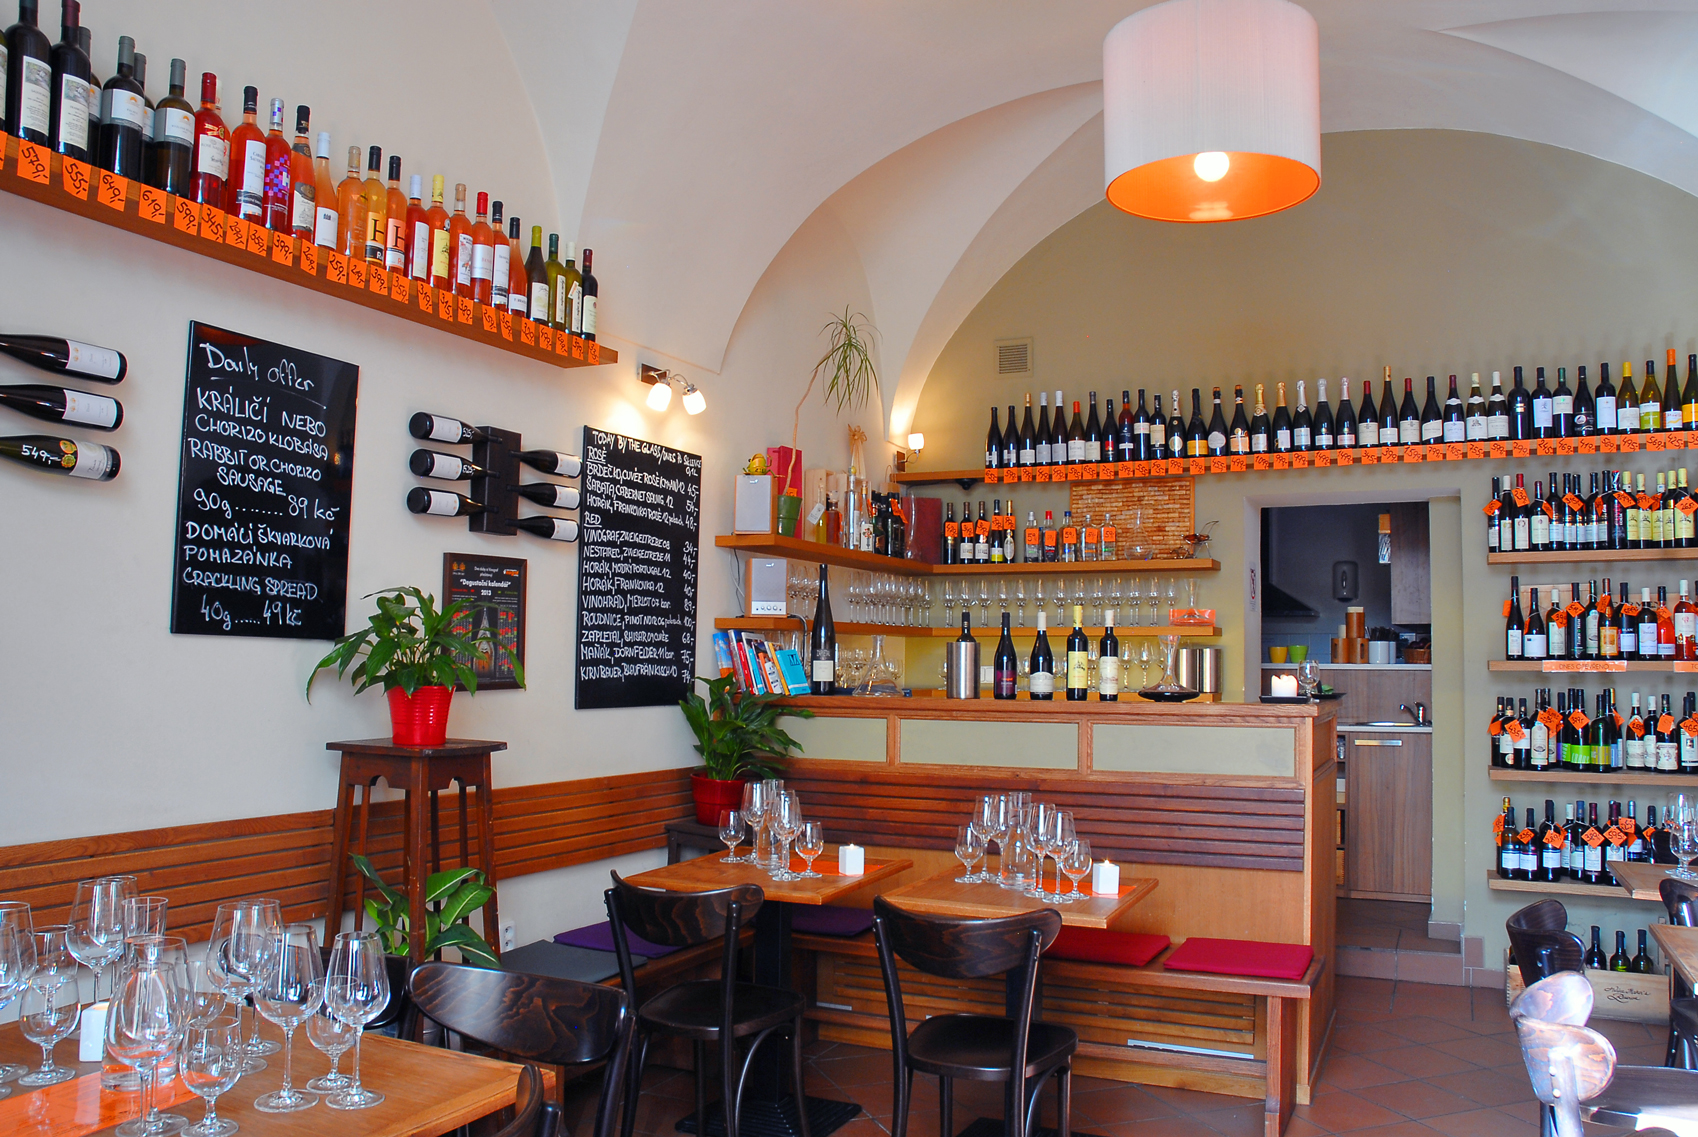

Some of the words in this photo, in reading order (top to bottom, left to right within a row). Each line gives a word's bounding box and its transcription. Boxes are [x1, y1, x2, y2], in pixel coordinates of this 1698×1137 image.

[200, 343, 258, 380] Daily
[268, 359, 314, 391] offer
[197, 386, 270, 423] KRÁLIČÍ
[282, 411, 326, 437] NEBO
[195, 414, 265, 443] CHORIZO
[269, 429, 328, 460] KLOBÁSA
[592, 431, 615, 450] TODAY
[618, 435, 627, 454] BY
[628, 438, 641, 453] THE
[188, 437, 248, 465] RABBIT
[249, 455, 269, 473] OR
[270, 459, 321, 481] CHORIZO
[217, 466, 286, 496] SAUSAGE
[584, 511, 601, 524] RED
[186, 521, 253, 544] DOMÁCÍ
[258, 523, 334, 549] ŠKVARKOVÁ
[183, 545, 293, 569] POMAZÁNKA
[183, 567, 261, 594] CRACKLING
[265, 577, 318, 600] SPREAD
[624, 614, 643, 625] PINOT
[614, 646, 658, 659] DORNFELDER
